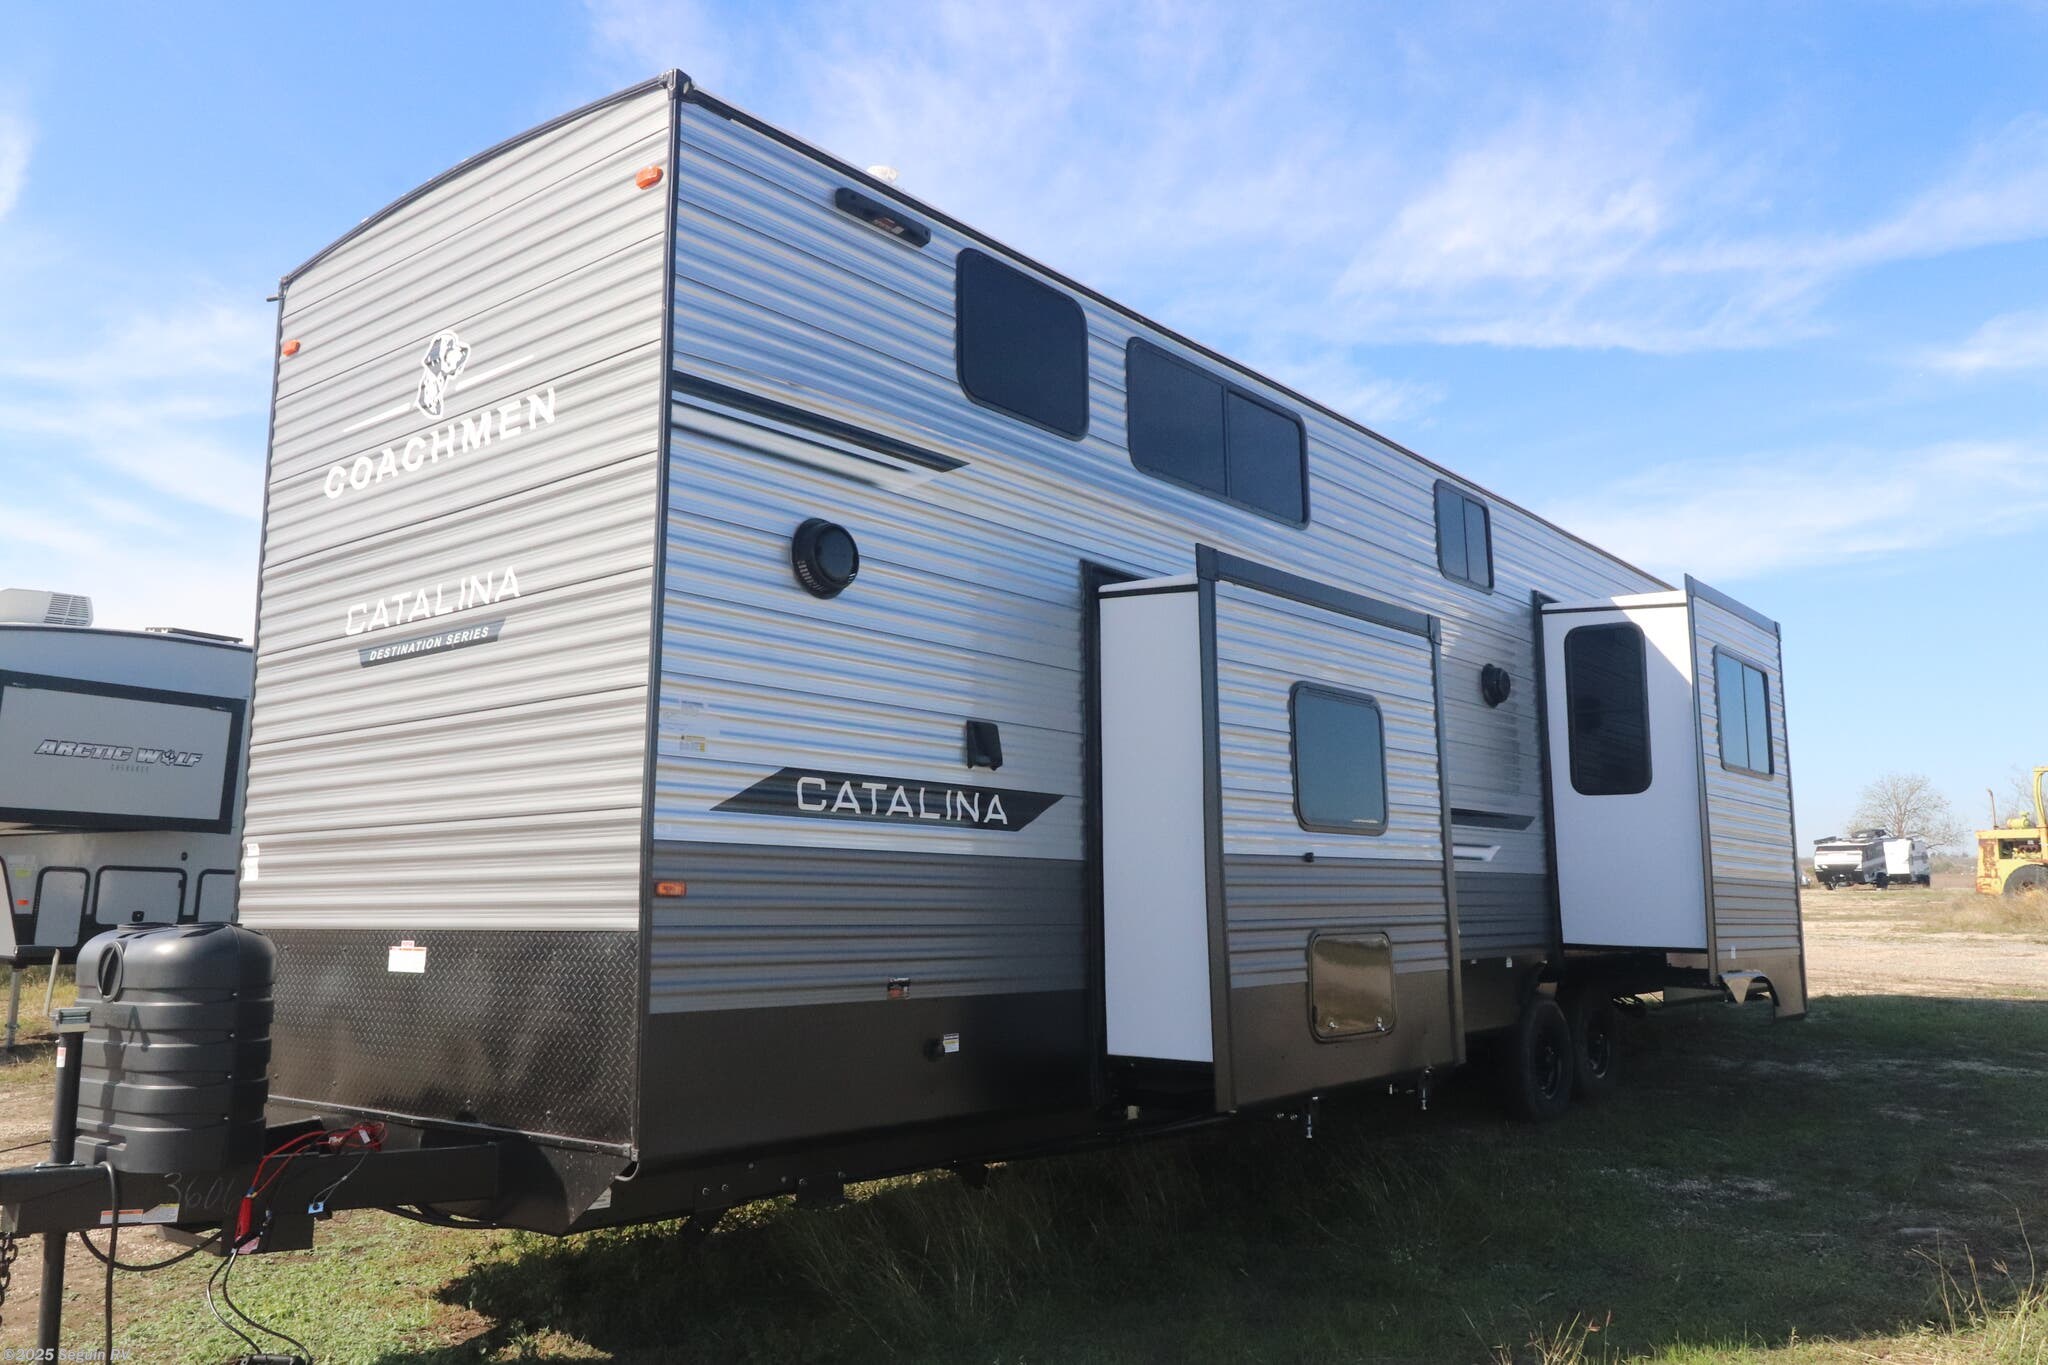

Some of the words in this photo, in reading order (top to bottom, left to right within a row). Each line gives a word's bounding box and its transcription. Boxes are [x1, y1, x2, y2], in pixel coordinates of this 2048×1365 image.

[323, 387, 557, 499] COACHMEN
[344, 566, 521, 636] CATALINA
[369, 637, 442, 661] DESTINATION
[445, 626, 490, 645] SERIES
[34, 739, 133, 762] ARCTIC
[796, 777, 1008, 825] CATALINA
